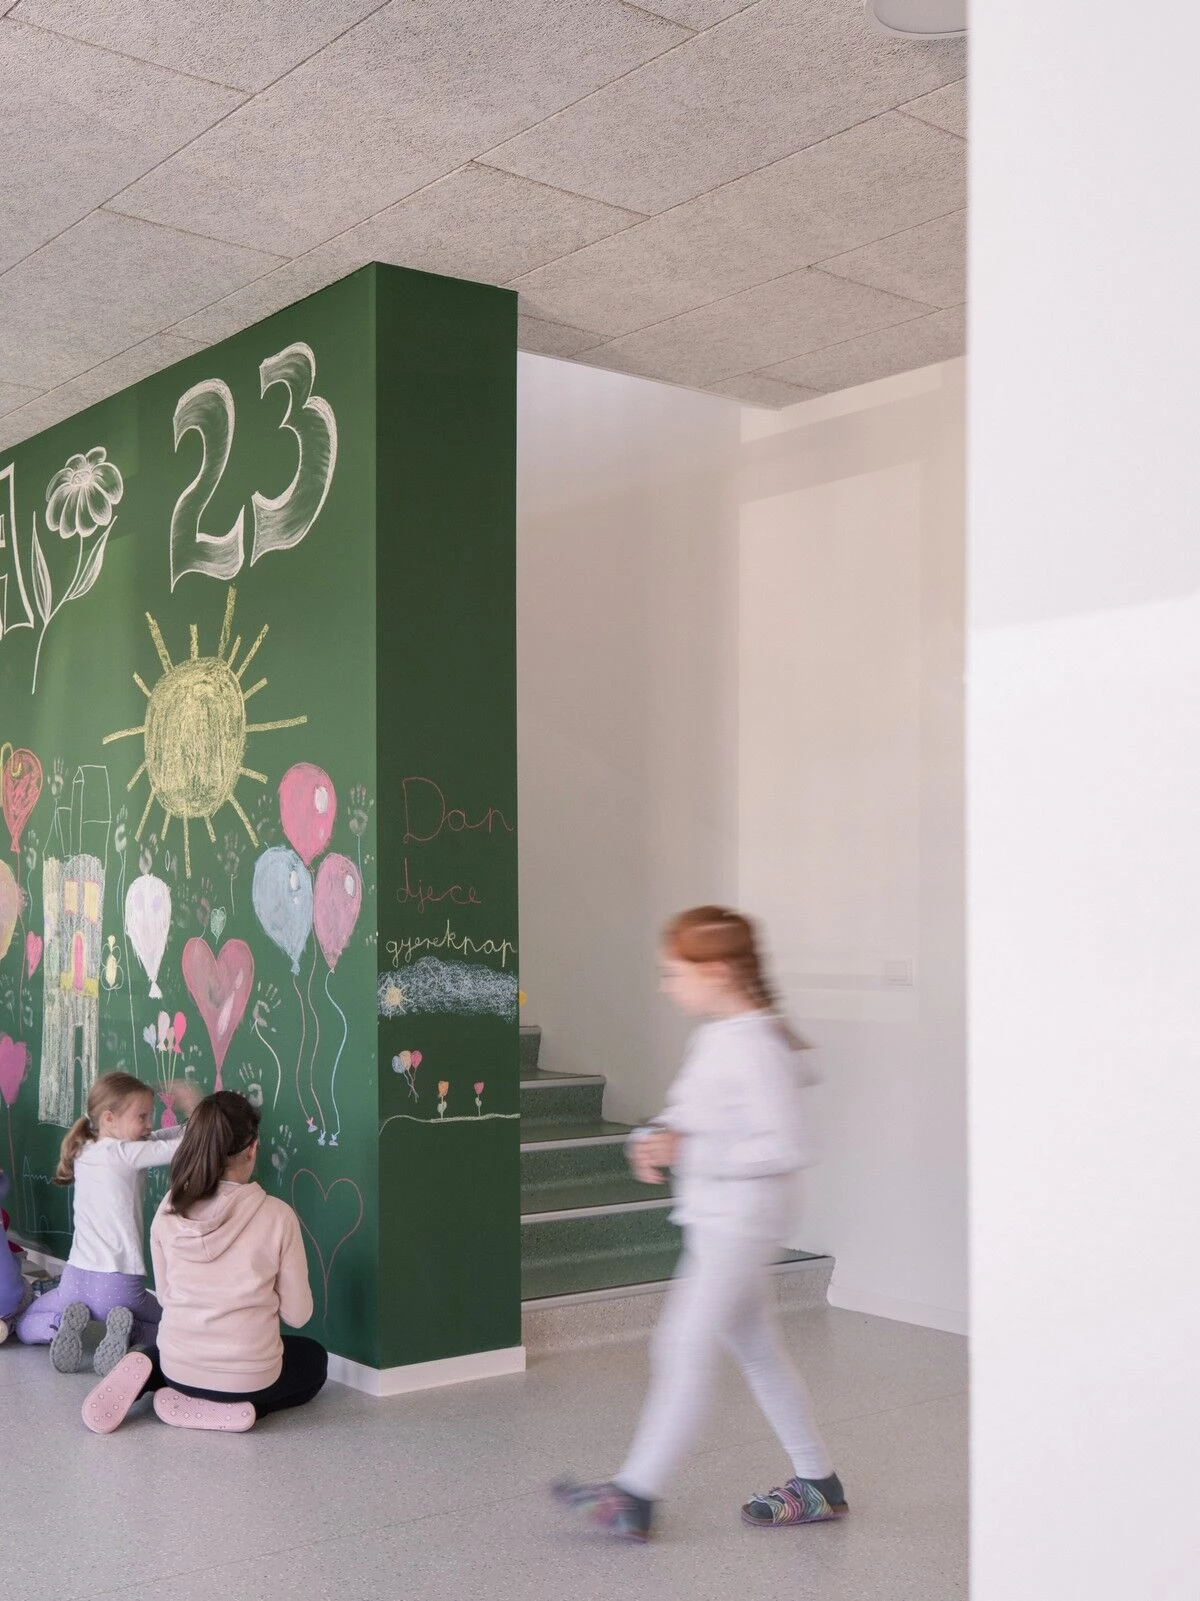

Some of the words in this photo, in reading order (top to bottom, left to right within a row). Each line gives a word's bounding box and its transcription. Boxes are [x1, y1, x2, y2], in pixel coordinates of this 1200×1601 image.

[170, 341, 338, 594] 23
[402, 776, 514, 844] Dan
[396, 857, 482, 914] djece
[385, 919, 518, 968] gyereknap
